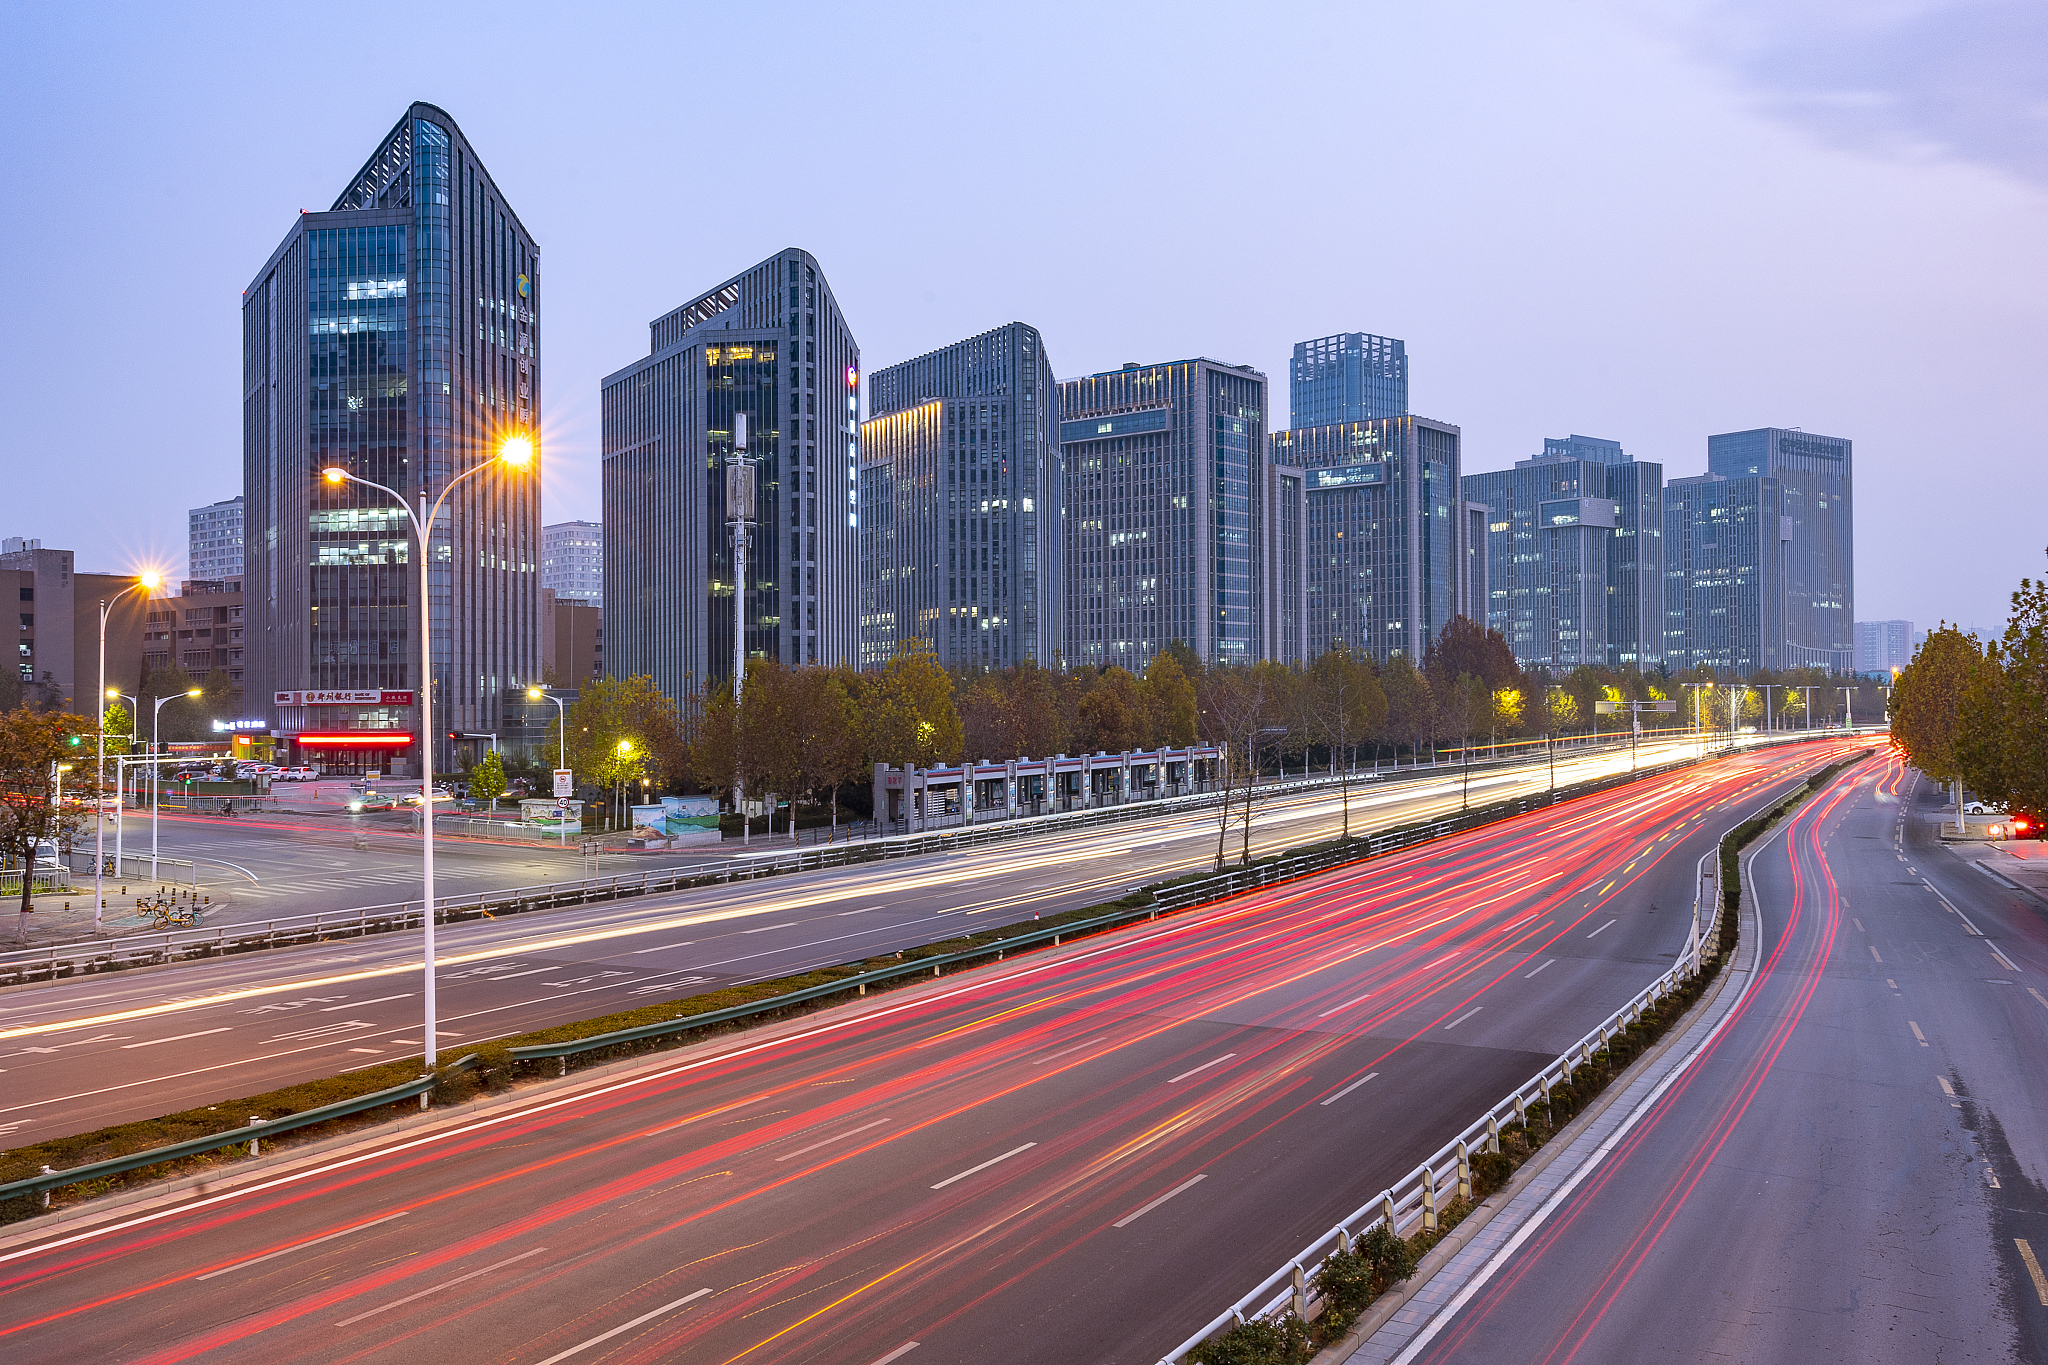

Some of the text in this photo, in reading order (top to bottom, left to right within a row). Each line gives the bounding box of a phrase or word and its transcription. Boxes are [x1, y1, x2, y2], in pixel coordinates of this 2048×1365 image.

[317, 692, 352, 702] 郑州银行
[888, 776, 902, 784] BRT
